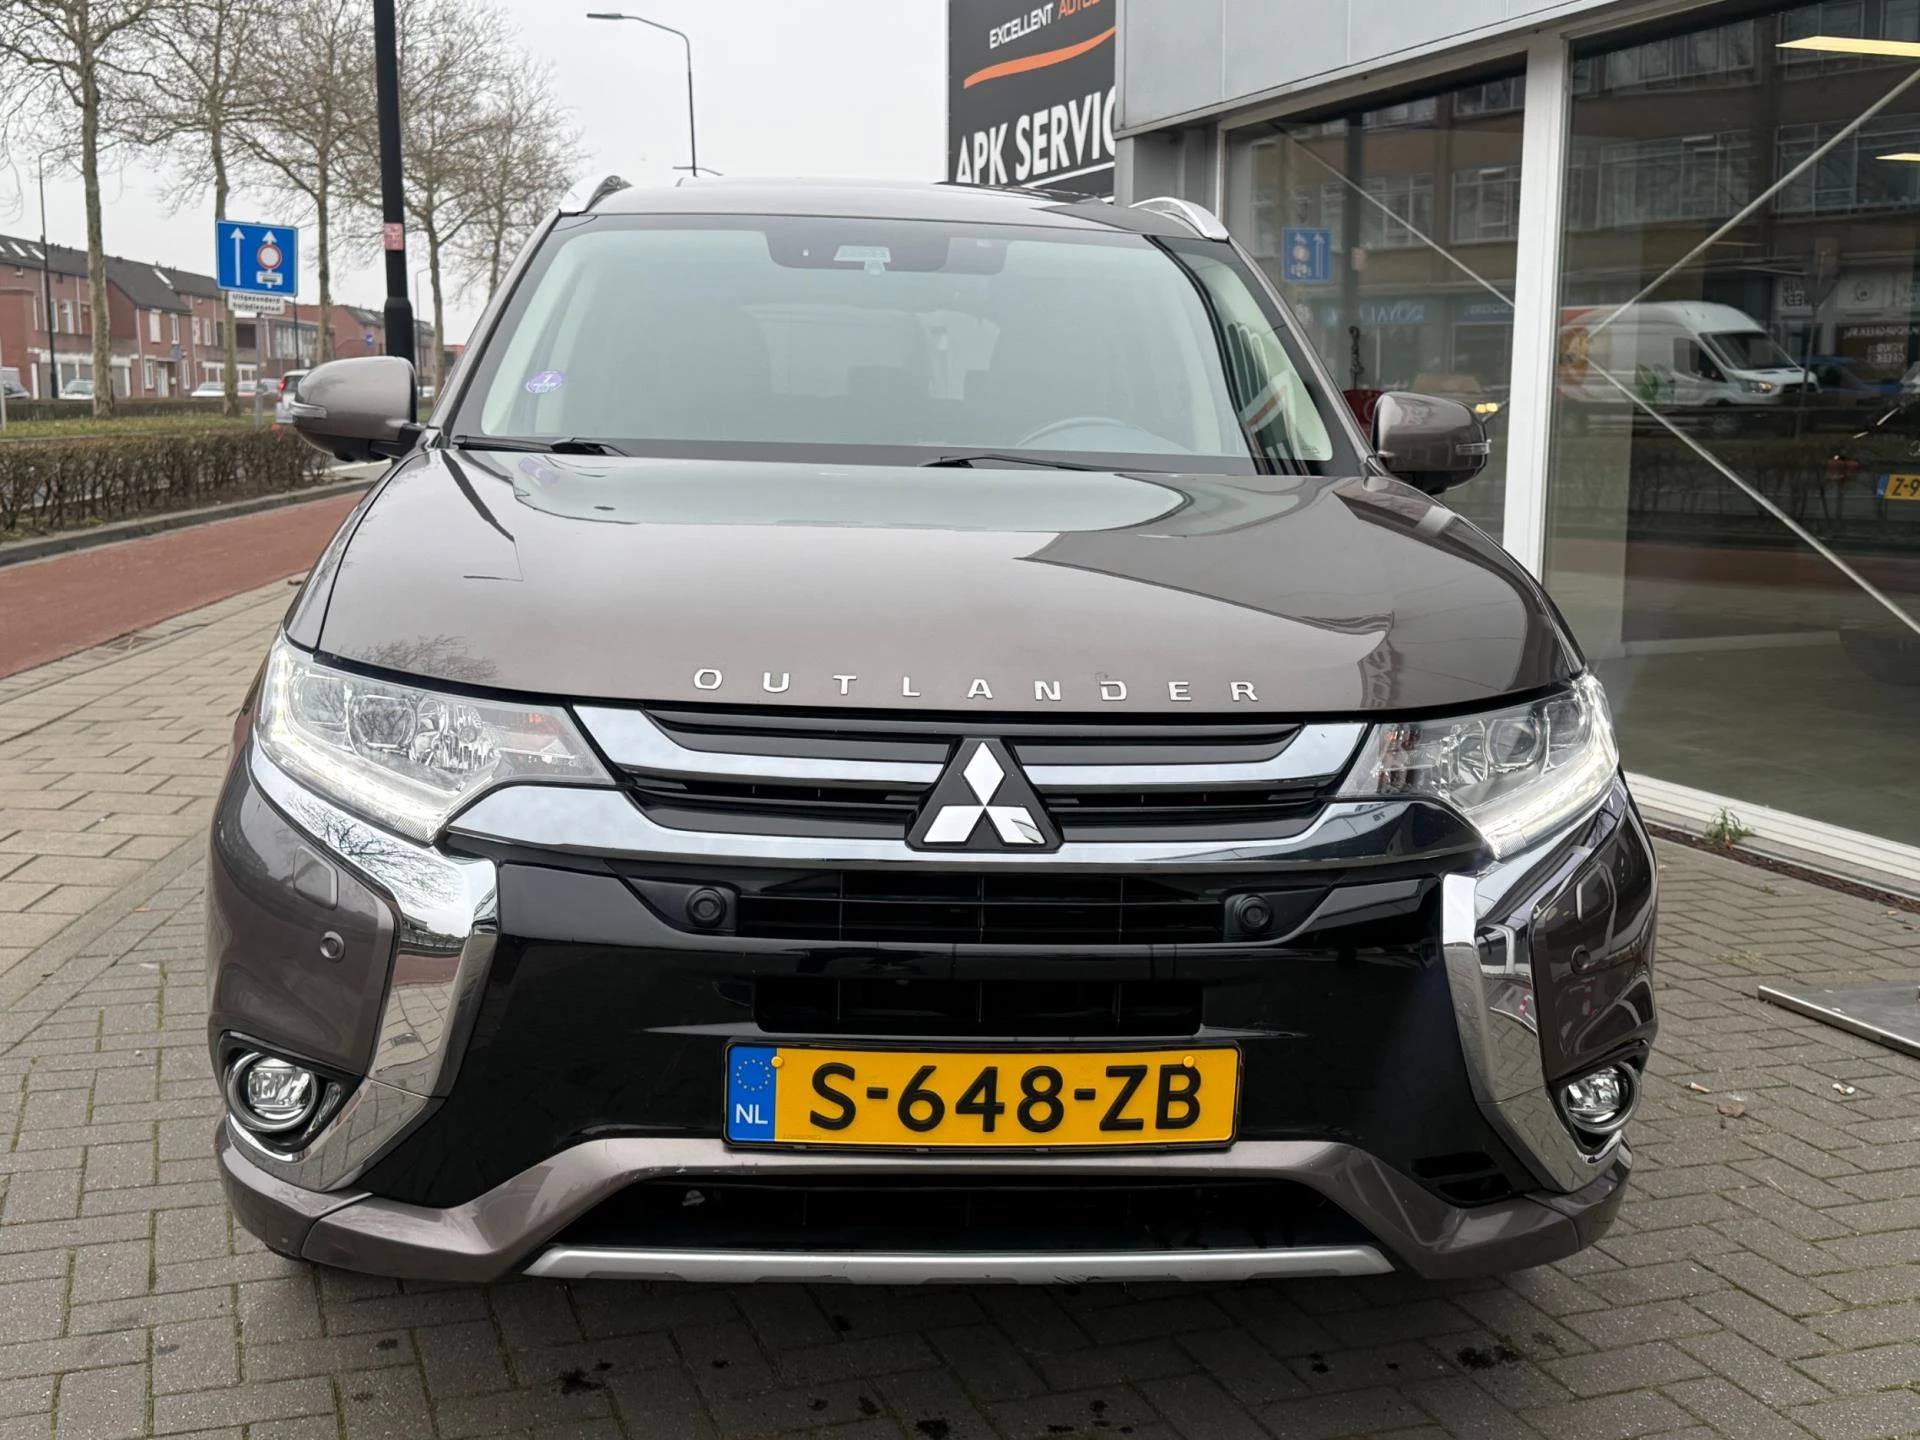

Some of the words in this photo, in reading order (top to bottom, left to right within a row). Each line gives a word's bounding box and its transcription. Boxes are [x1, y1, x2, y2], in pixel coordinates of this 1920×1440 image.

[989, 2, 1054, 49] EXCELLENT
[955, 123, 1009, 185] APK
[693, 667, 1260, 702] OUTLANDER
[735, 1103, 768, 1125] NL
[809, 1062, 1202, 1134] S-648-ZB
